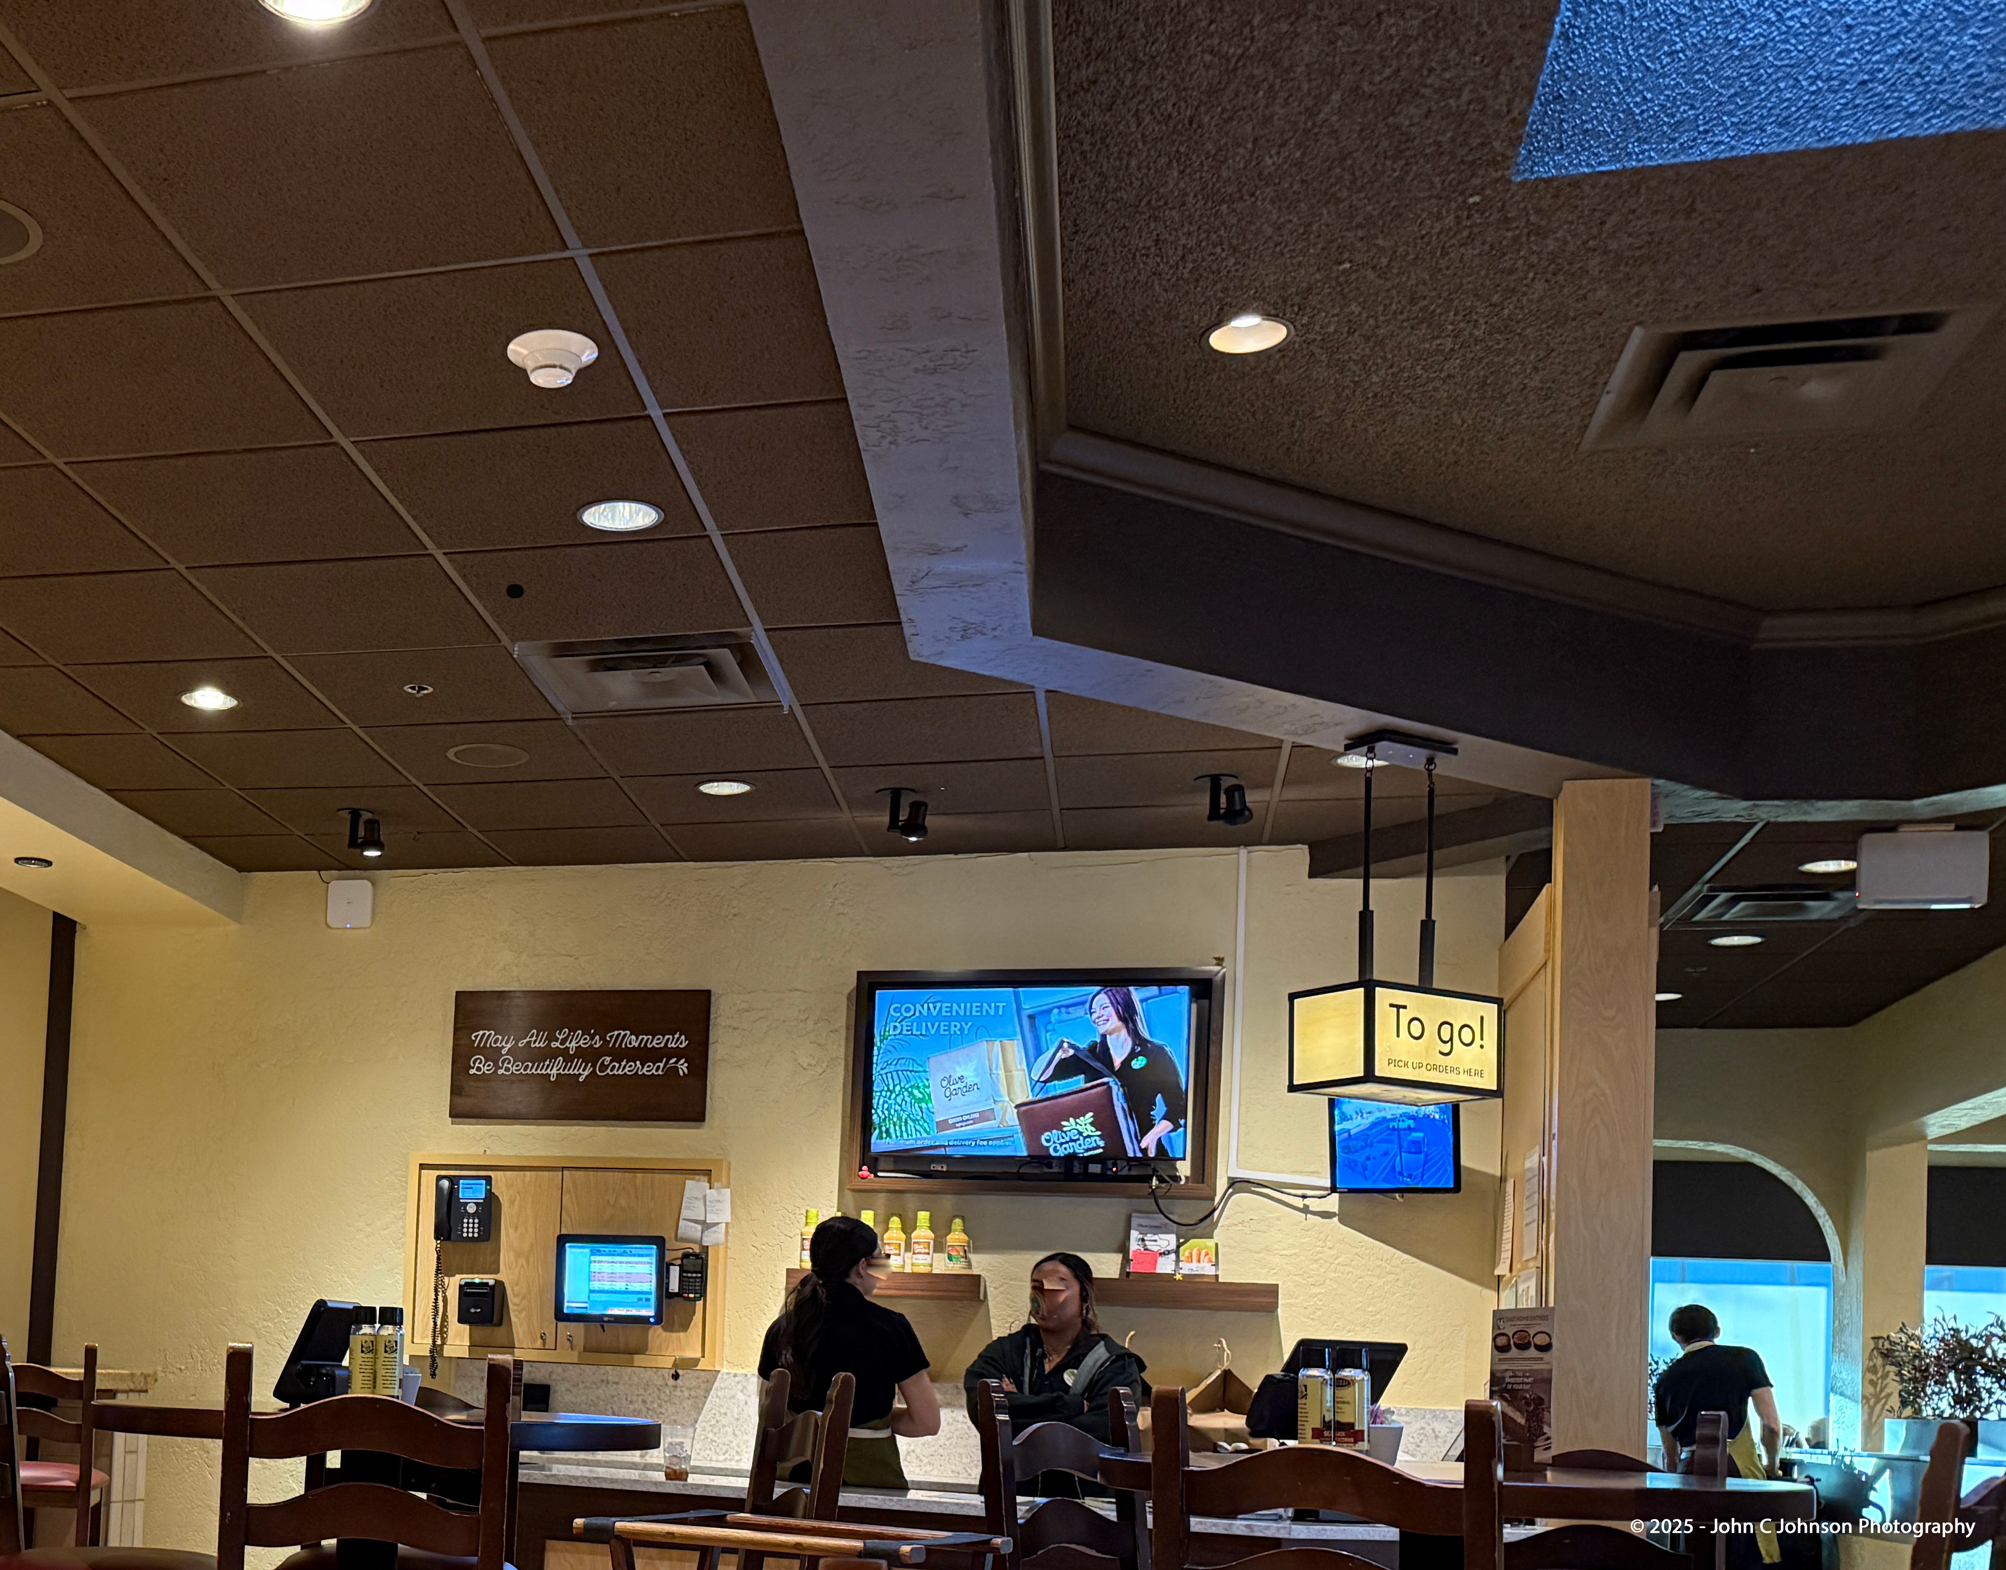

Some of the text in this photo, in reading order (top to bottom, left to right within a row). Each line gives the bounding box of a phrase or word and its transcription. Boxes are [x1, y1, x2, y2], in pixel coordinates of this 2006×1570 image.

[890, 1002, 1007, 1017] CONVENIENT
[889, 1021, 973, 1036] DELIVERY
[1388, 1002, 1486, 1057] To go!
[471, 1028, 689, 1055] May All Life's Moments
[468, 1055, 667, 1082] Be Beautifully Catered
[1387, 1057, 1485, 1079] PICK UP ORDERS HERE
[940, 1074, 965, 1089] Olive
[943, 1081, 981, 1102] Garden
[1041, 1129, 1080, 1147] Olive
[1049, 1135, 1106, 1157] Garden
